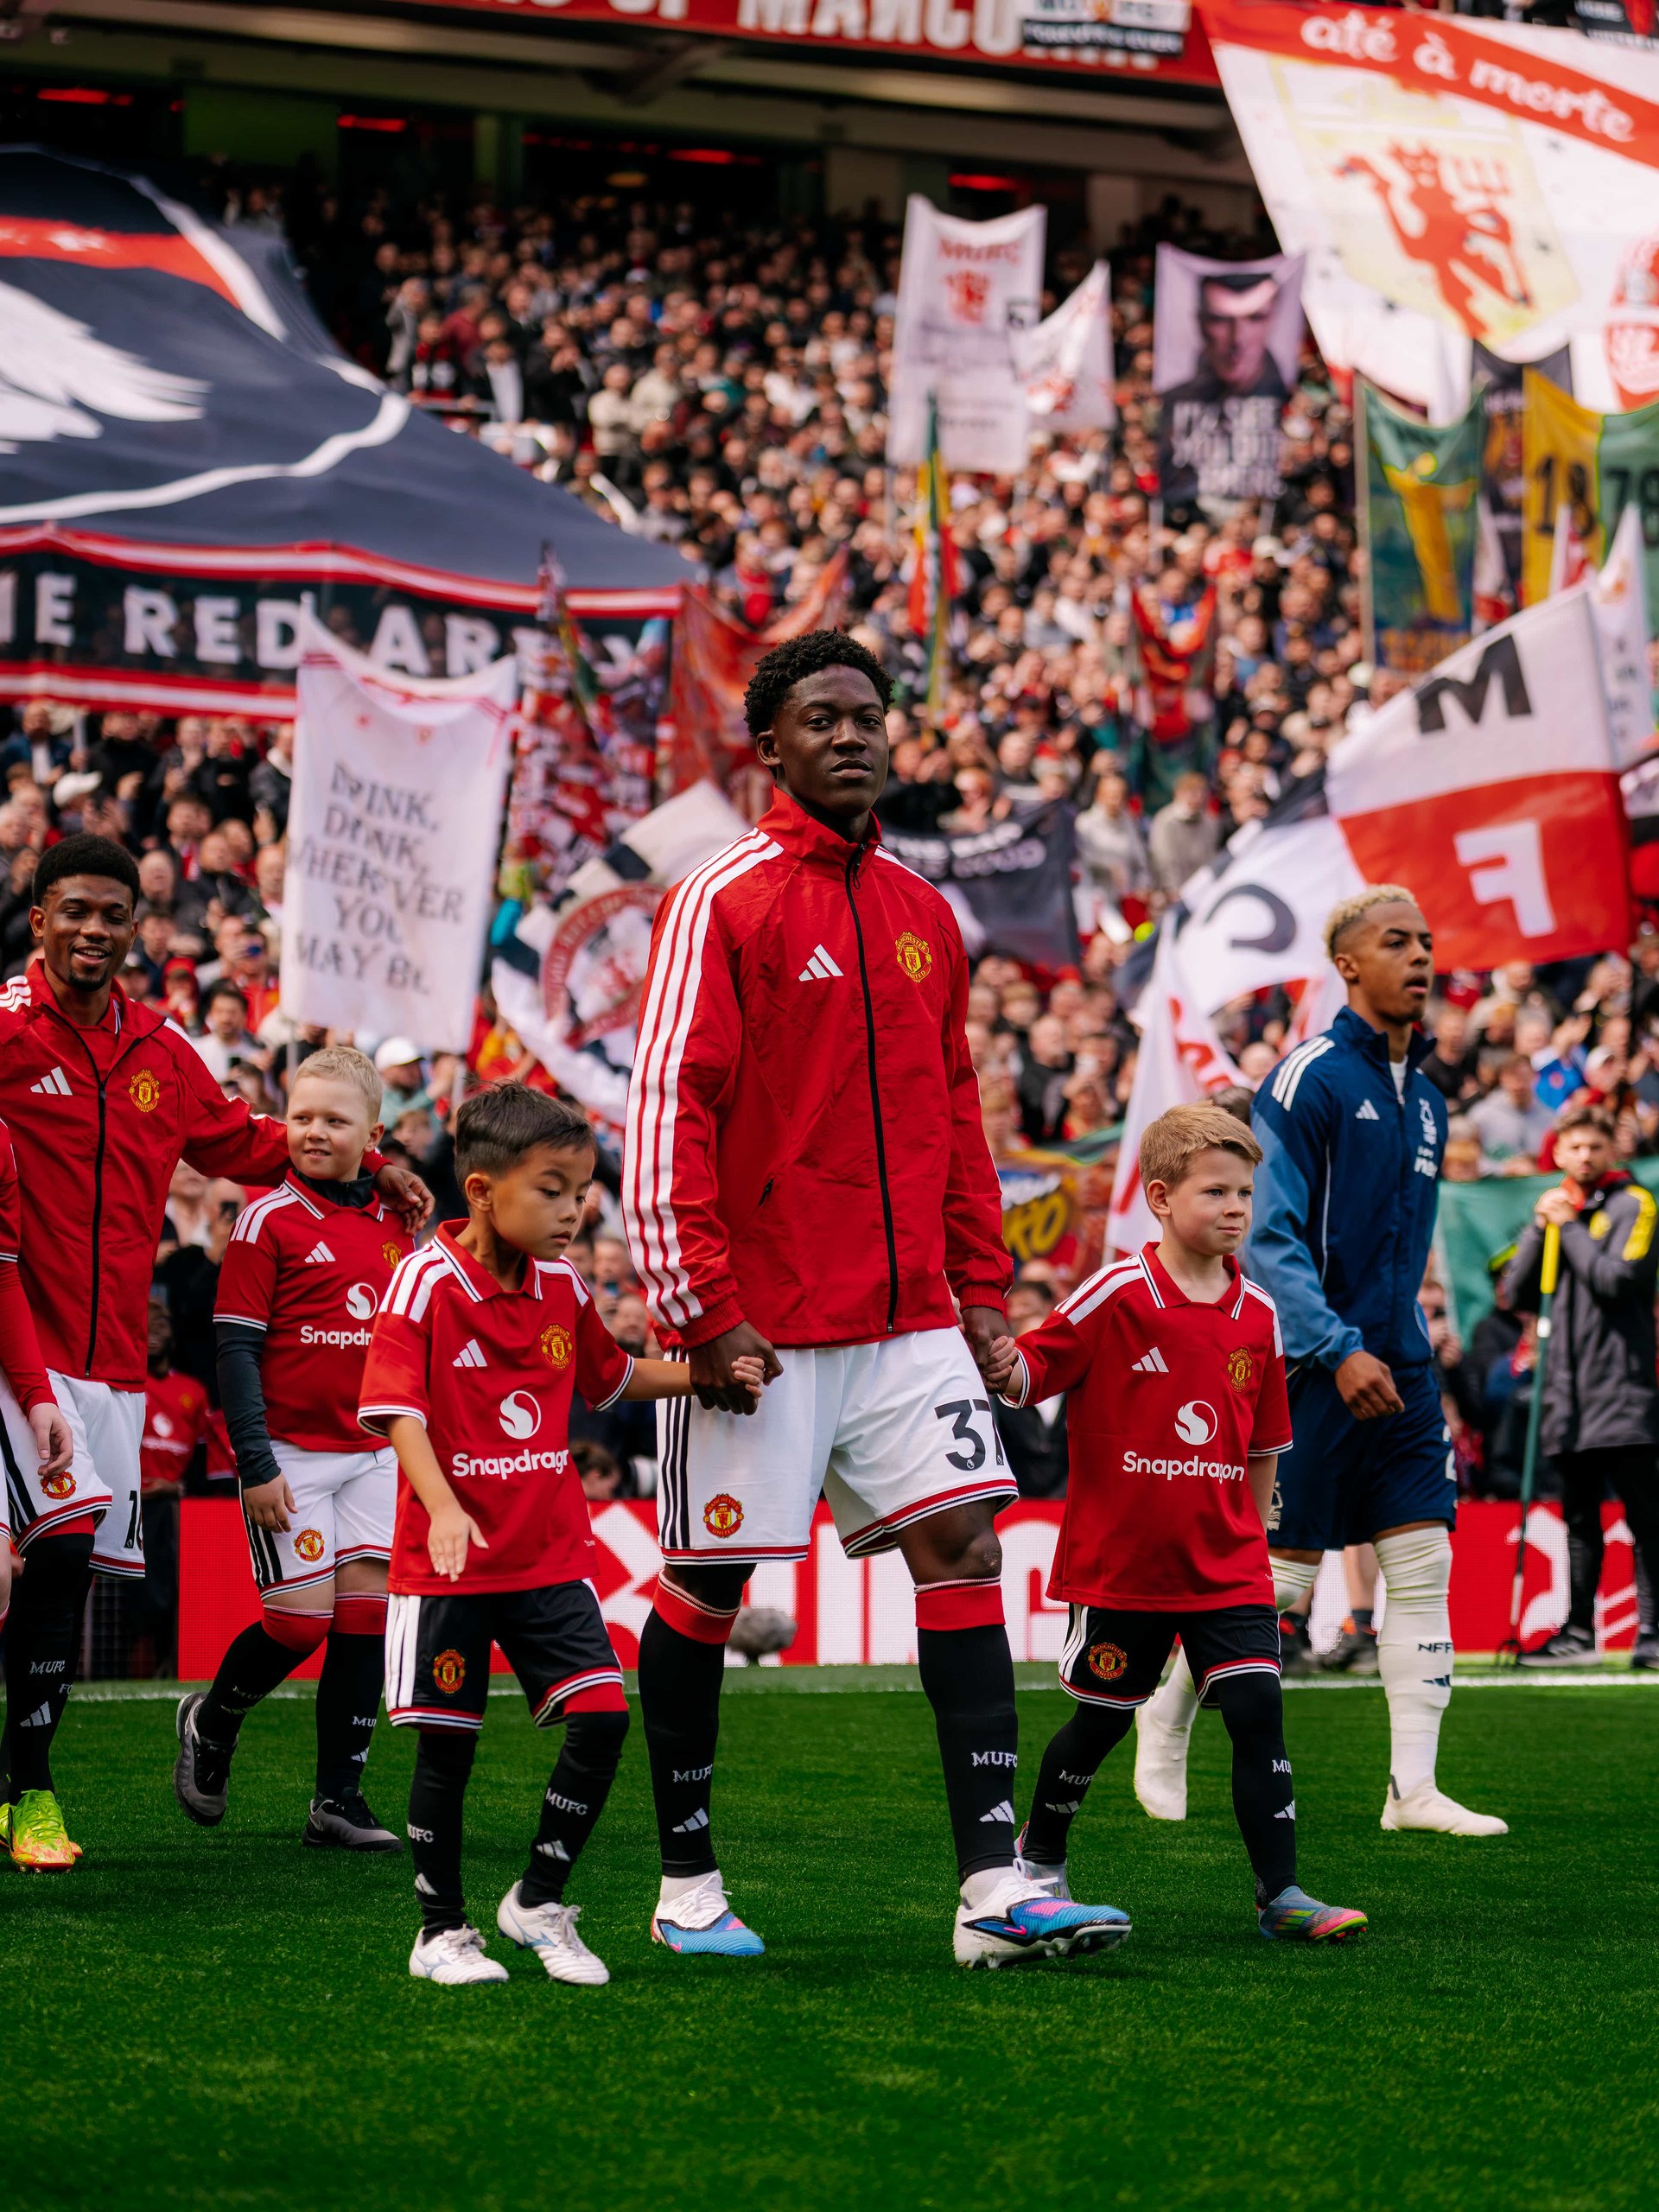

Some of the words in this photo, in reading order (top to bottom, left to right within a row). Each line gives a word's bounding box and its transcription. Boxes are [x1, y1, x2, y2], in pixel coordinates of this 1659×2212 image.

[1300, 10, 1399, 61] até
[1413, 31, 1459, 80] à
[1470, 60, 1637, 142] morte
[124, 585, 302, 670] RED
[452, 1448, 569, 1480] Snapdrag
[934, 1398, 1005, 1471] 37
[124, 1490, 143, 1551] 1
[29, 1660, 66, 1675] MUFC
[545, 1788, 588, 1815] MUFC
